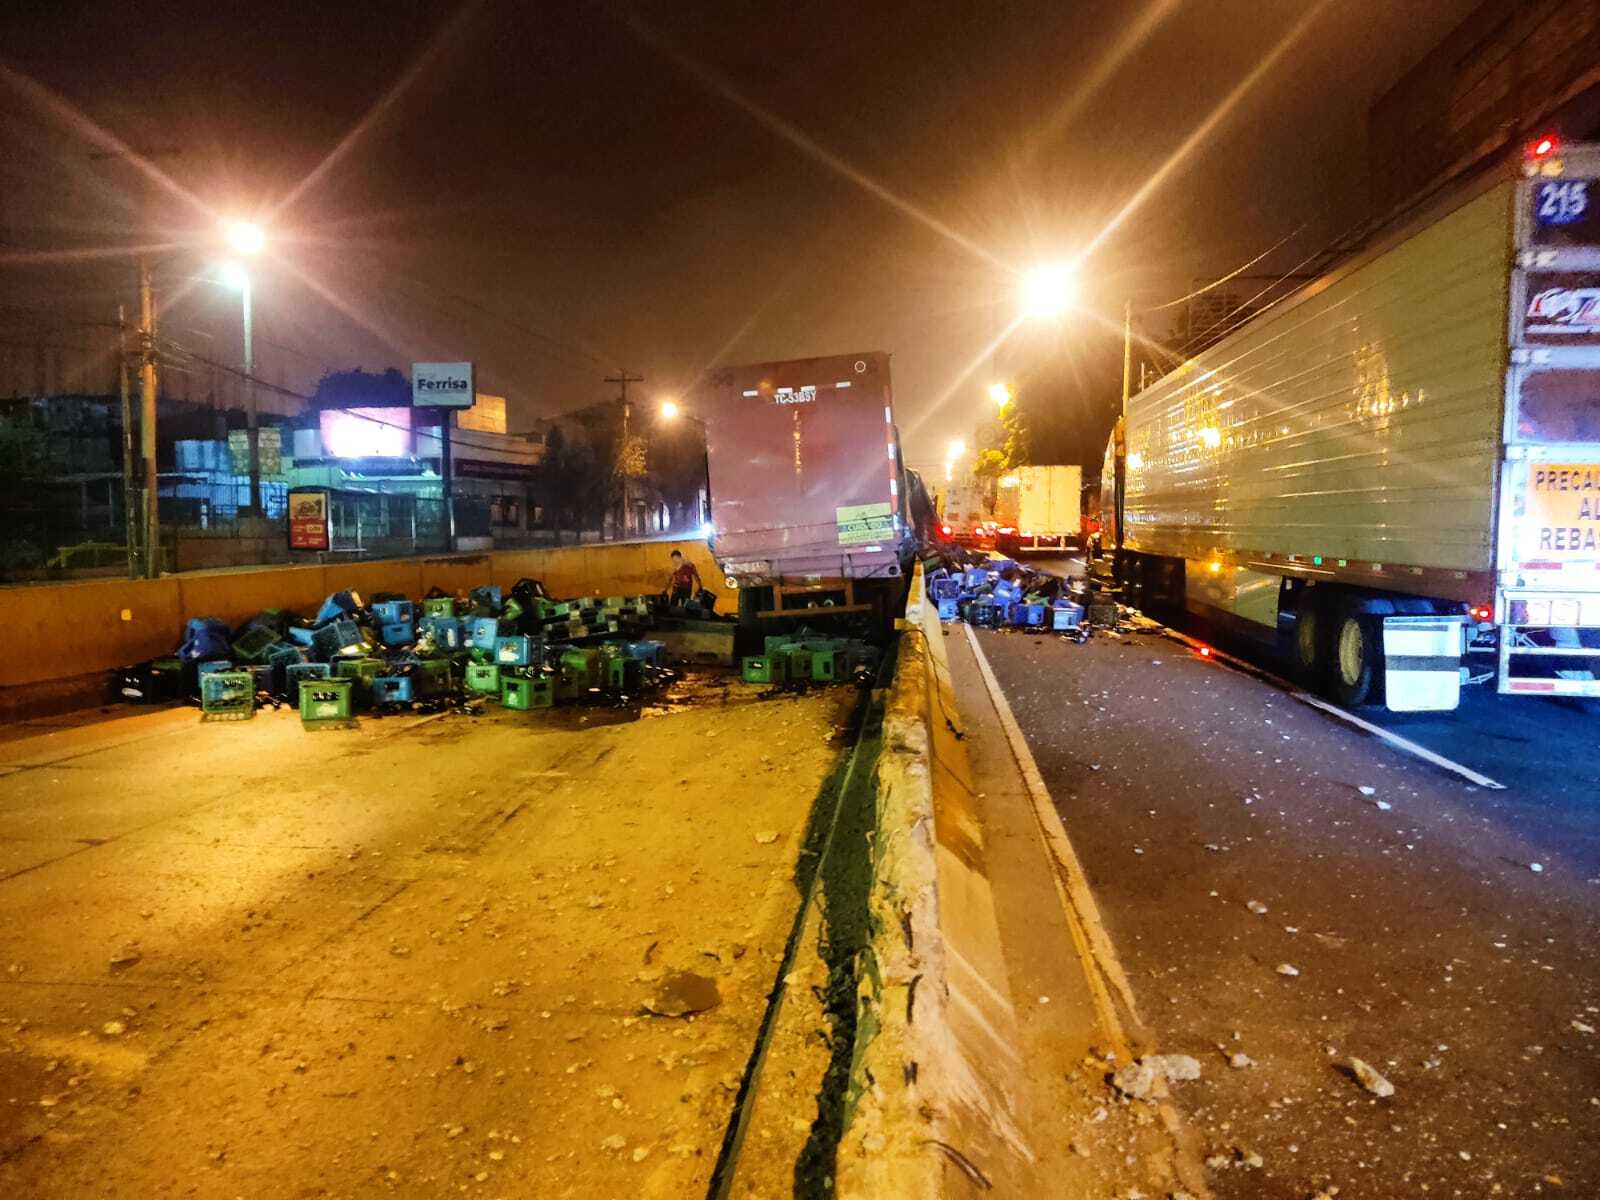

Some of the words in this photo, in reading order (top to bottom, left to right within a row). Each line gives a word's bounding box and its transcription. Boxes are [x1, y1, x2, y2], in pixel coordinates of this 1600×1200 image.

[1538, 182, 1587, 216] 215
[417, 377, 467, 389] Ferrisa
[1539, 527, 1600, 551] REBA
